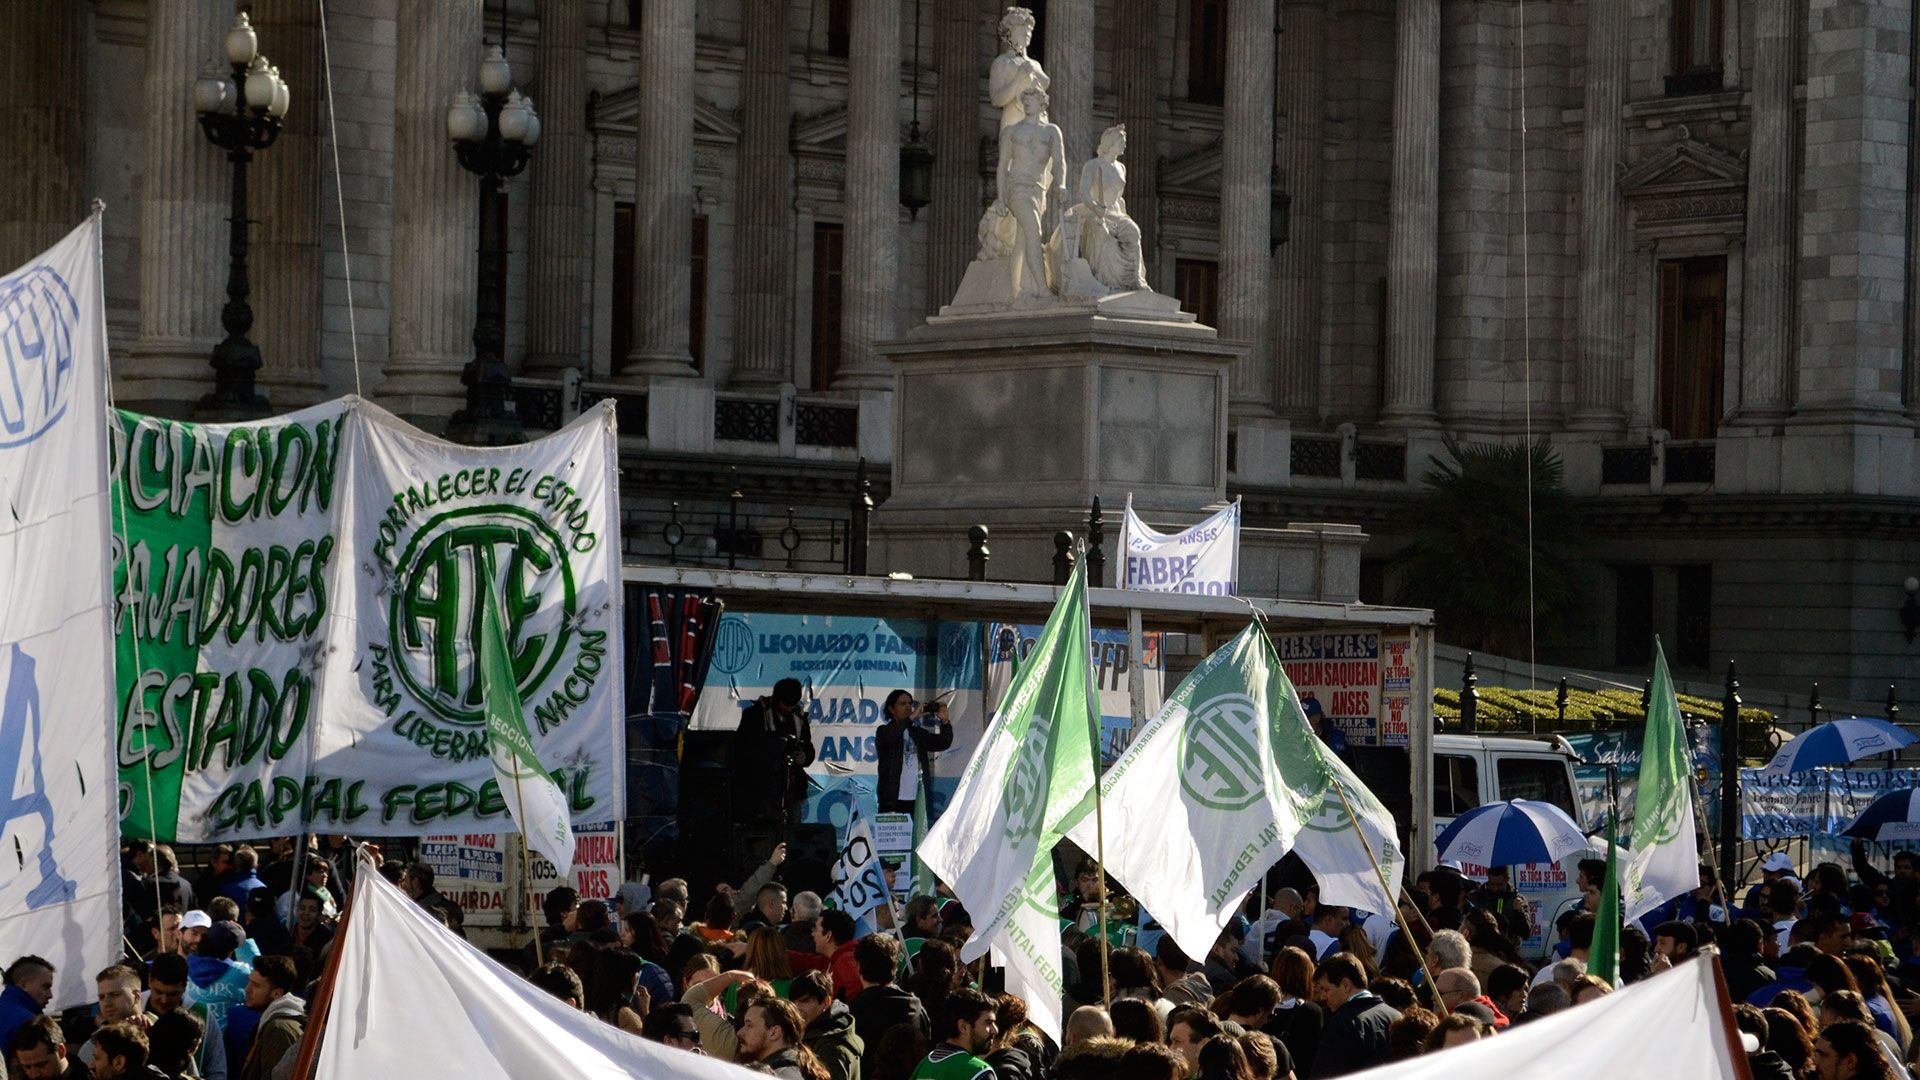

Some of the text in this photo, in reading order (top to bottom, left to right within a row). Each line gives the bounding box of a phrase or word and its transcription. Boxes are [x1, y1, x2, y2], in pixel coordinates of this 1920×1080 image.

[373, 467, 596, 564] FORTALECER EL ESTADO
[1179, 527, 1218, 545] ANSES
[1127, 554, 1198, 584] FABRE
[400, 525, 553, 706] ATE
[758, 633, 870, 654] LEONARDO
[1334, 636, 1370, 657] F.G.S.
[790, 660, 905, 673] SECRETARIO GENERAL
[1386, 667, 1409, 678] SE TOCA
[1393, 655, 1403, 666] NO
[368, 641, 402, 718] PARA
[535, 629, 607, 737] NACION
[1325, 662, 1377, 688] SAQUEAN
[1331, 691, 1369, 716] ANSES
[119, 668, 311, 772] ESTADO
[1384, 722, 1407, 734] SE TOCA
[1391, 711, 1401, 722] NO
[208, 776, 369, 834] CAPTAL
[577, 869, 611, 900] ANSES
